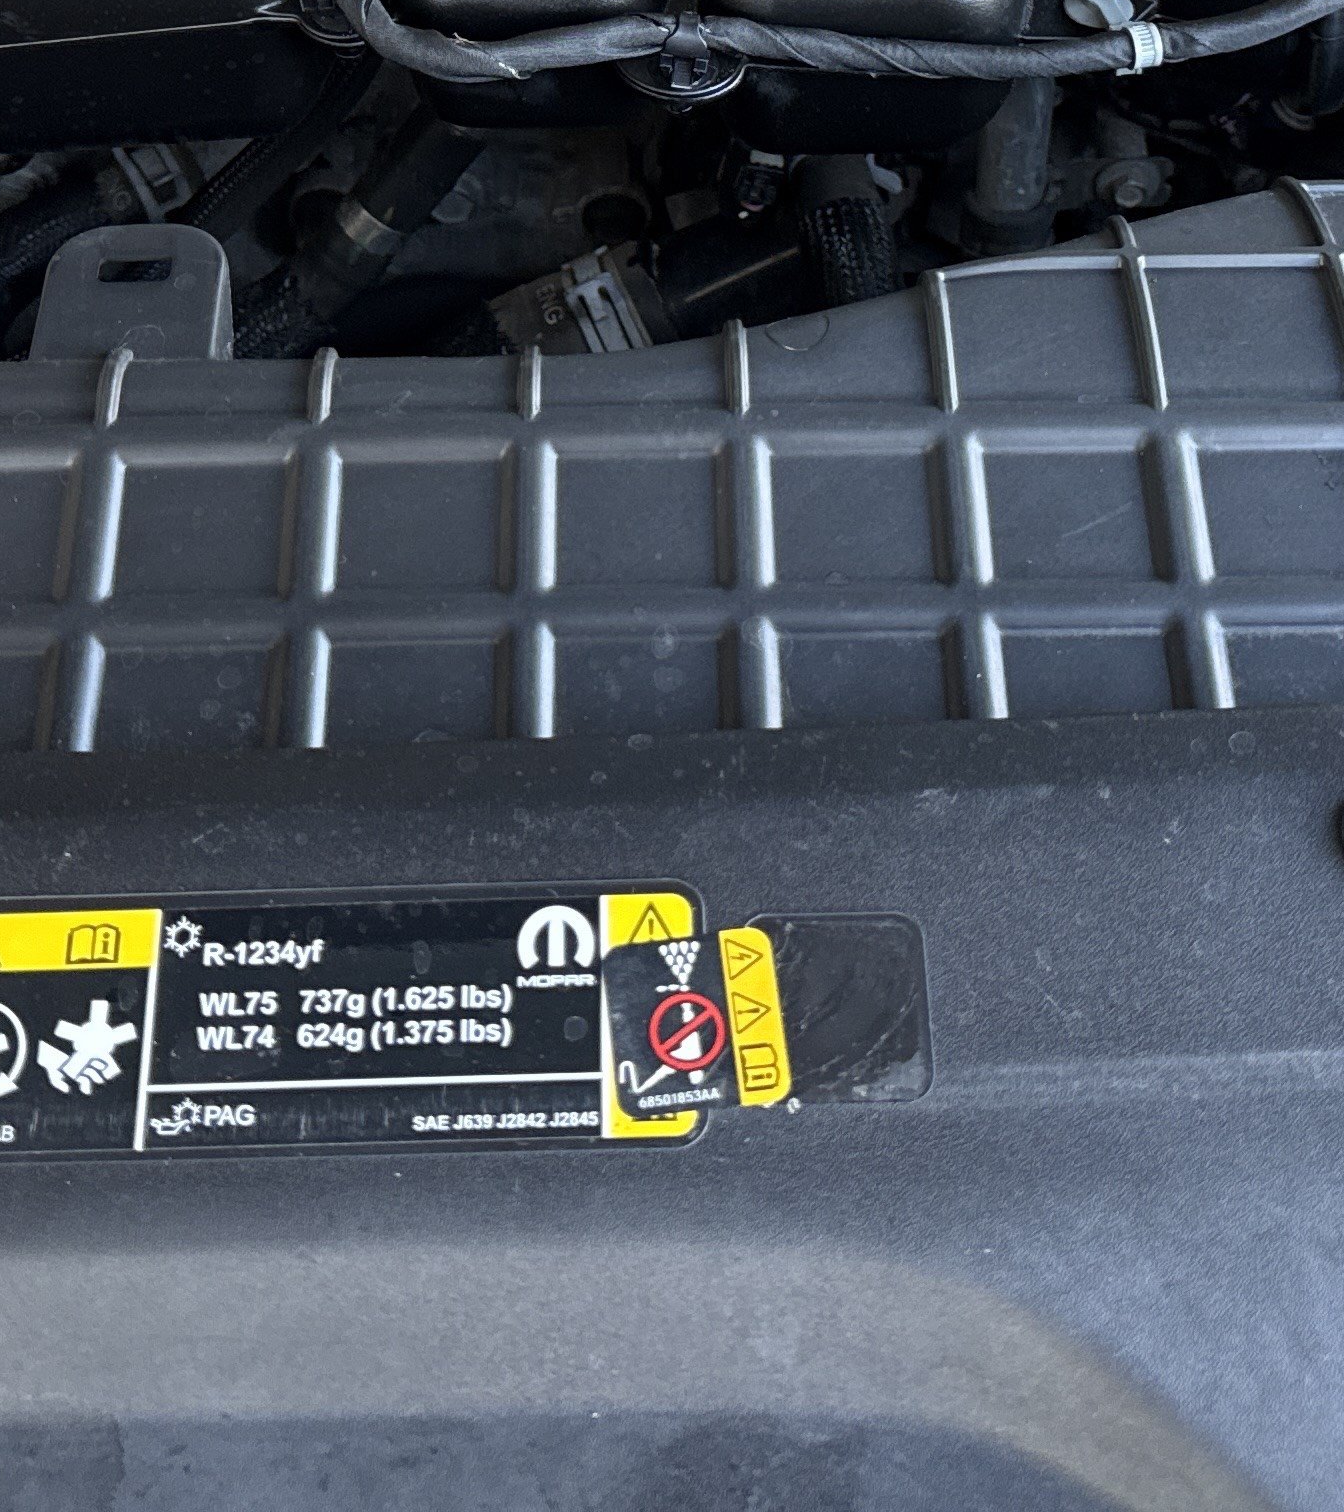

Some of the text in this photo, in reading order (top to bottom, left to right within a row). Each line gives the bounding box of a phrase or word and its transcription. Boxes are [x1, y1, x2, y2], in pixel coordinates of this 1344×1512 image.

[202, 939, 325, 969] R-1234yf
[516, 974, 596, 988] MOPAR
[199, 983, 513, 1018] WL75 737g (1.625 lbs)
[196, 1017, 513, 1053] WL74 624g (1.375 lbs)
[637, 1087, 721, 1109] 68501853AA
[203, 1104, 257, 1127] PAG
[412, 1110, 599, 1132] SAE J639 J2842 J2845
